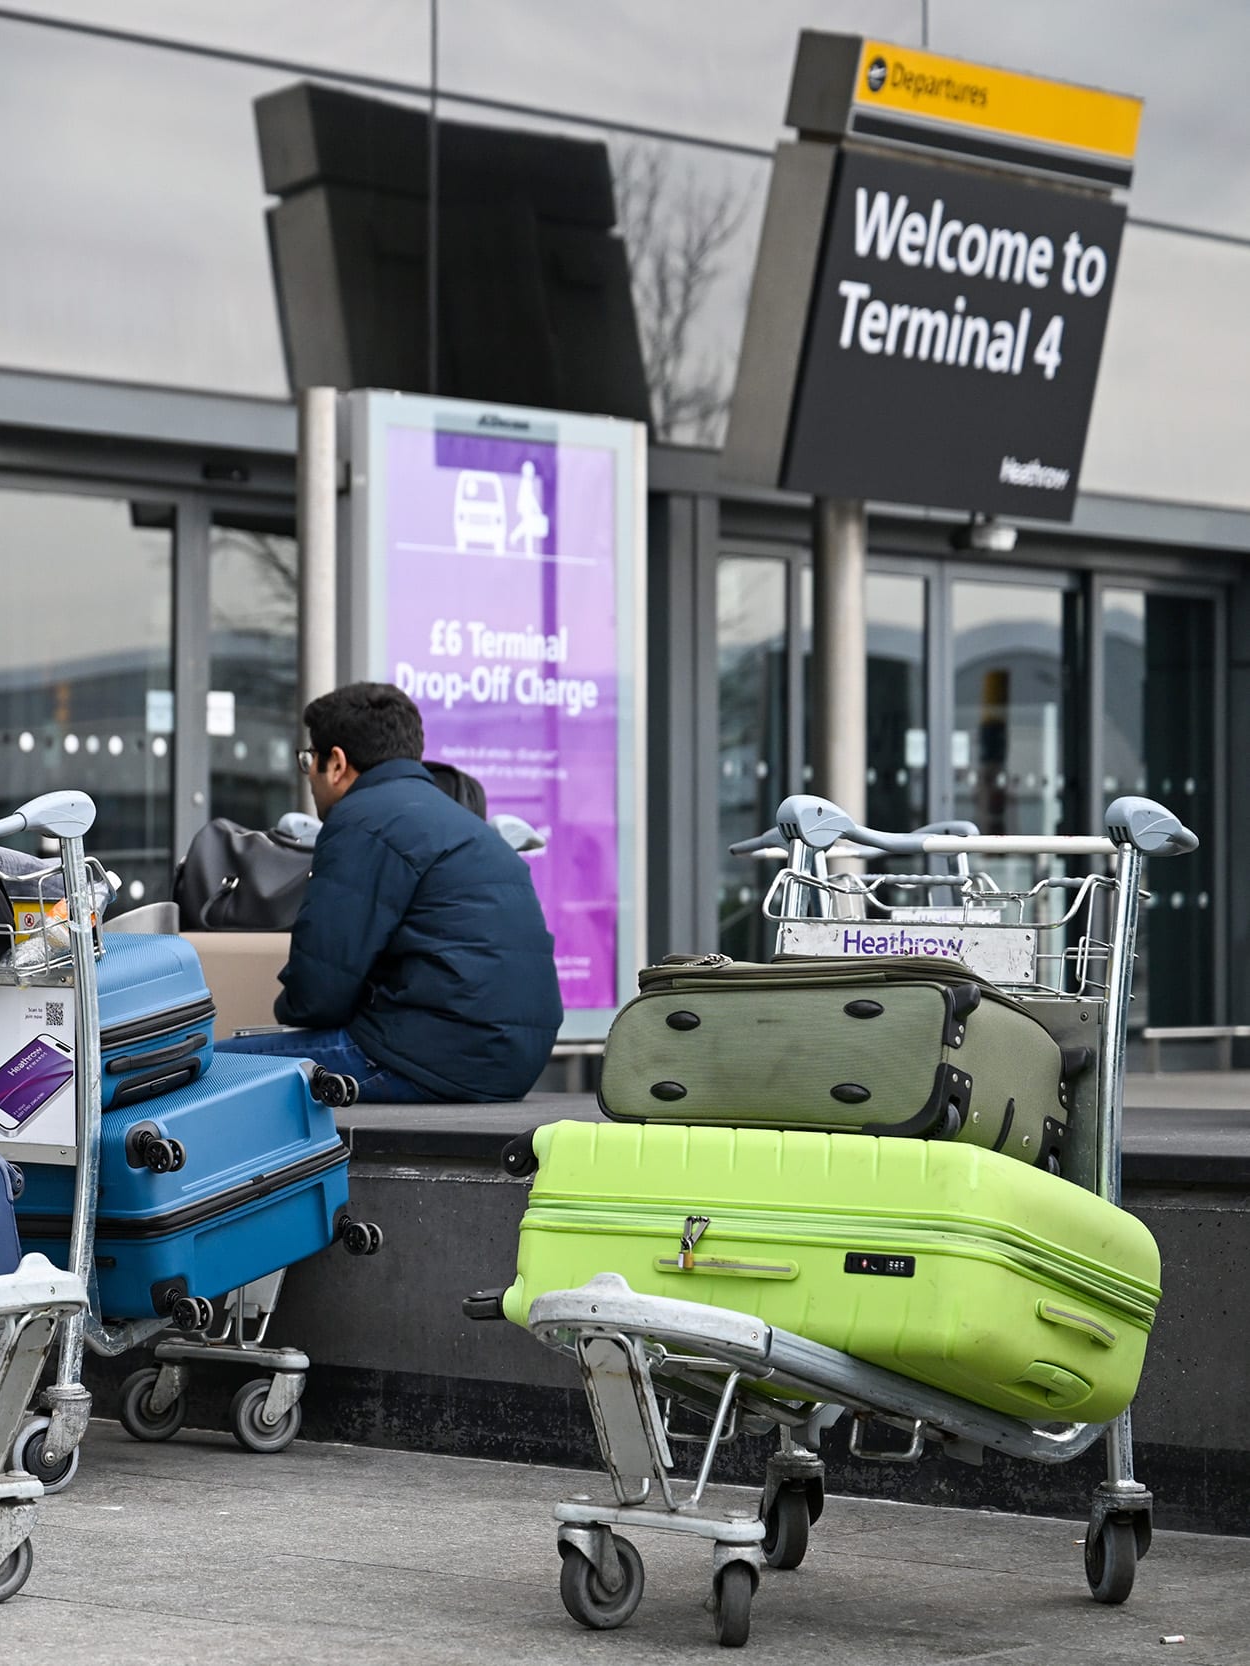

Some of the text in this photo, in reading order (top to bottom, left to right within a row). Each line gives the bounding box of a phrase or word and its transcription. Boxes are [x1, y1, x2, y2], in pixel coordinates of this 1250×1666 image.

[890, 61, 989, 108] Departures
[855, 186, 1108, 297] Welcome to
[838, 280, 1064, 380] Terminal 4
[999, 455, 1070, 490] Heathrow
[429, 618, 568, 664] £6 Terminal
[395, 661, 599, 716] Drop-Off Charge
[843, 929, 964, 956] Heathrow
[6, 1046, 44, 1077] Heathrow
